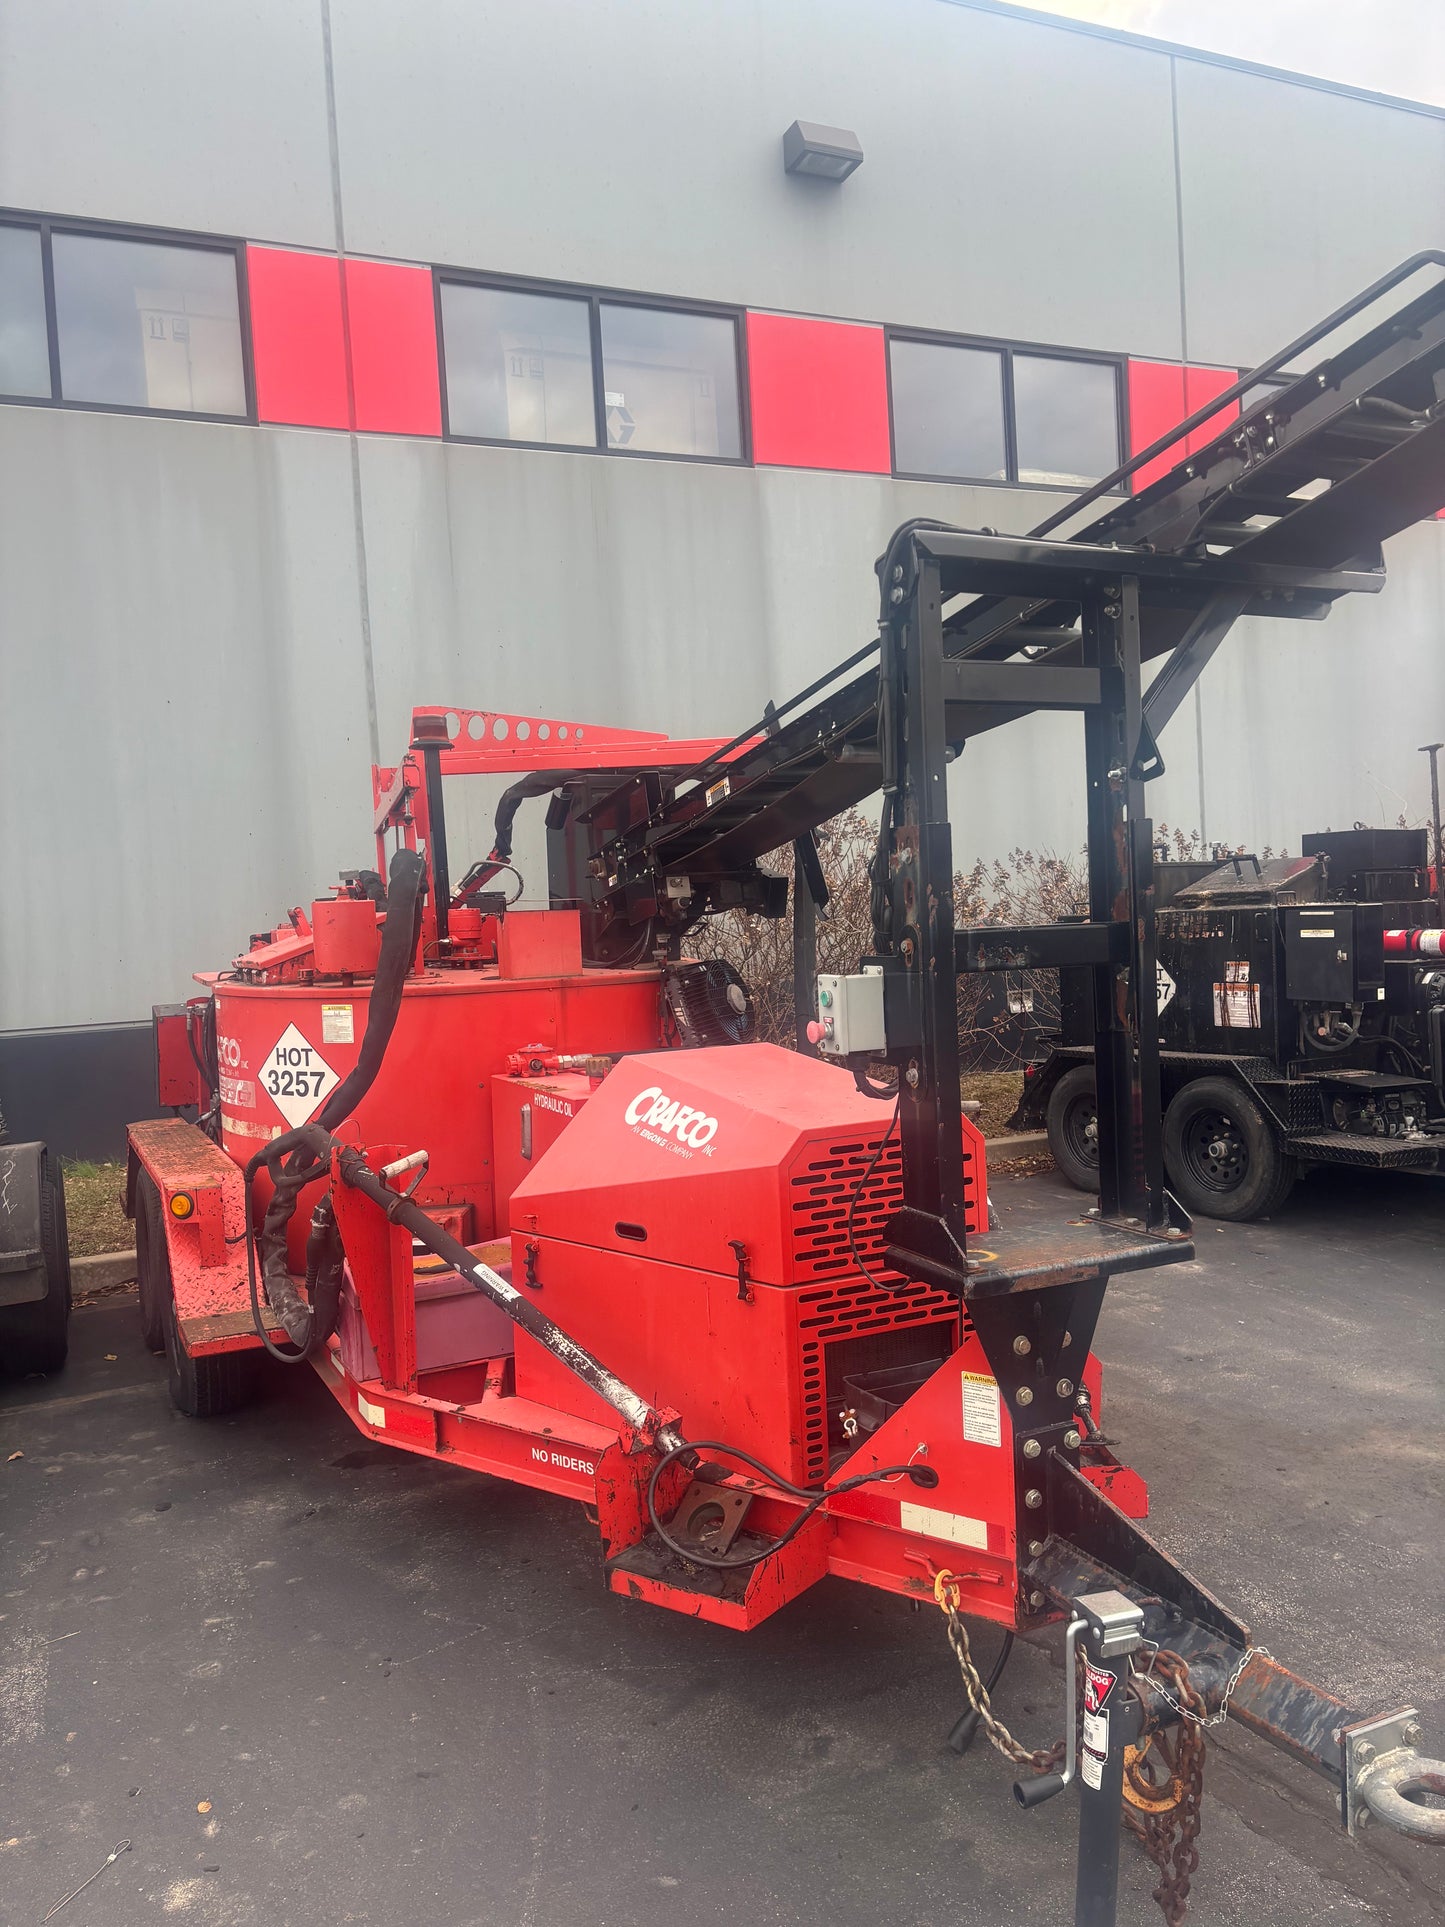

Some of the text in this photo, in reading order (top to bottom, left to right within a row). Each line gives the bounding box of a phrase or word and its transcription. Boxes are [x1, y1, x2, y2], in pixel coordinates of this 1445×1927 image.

[276, 1048, 313, 1067] HOT
[267, 1070, 326, 1098] 3257
[534, 1092, 573, 1117] HYDRAULIC OIL
[624, 1086, 719, 1157] CRAFCO INC
[969, 1375, 997, 1385] WARNING
[531, 1447, 595, 1475] NO RIDERS
